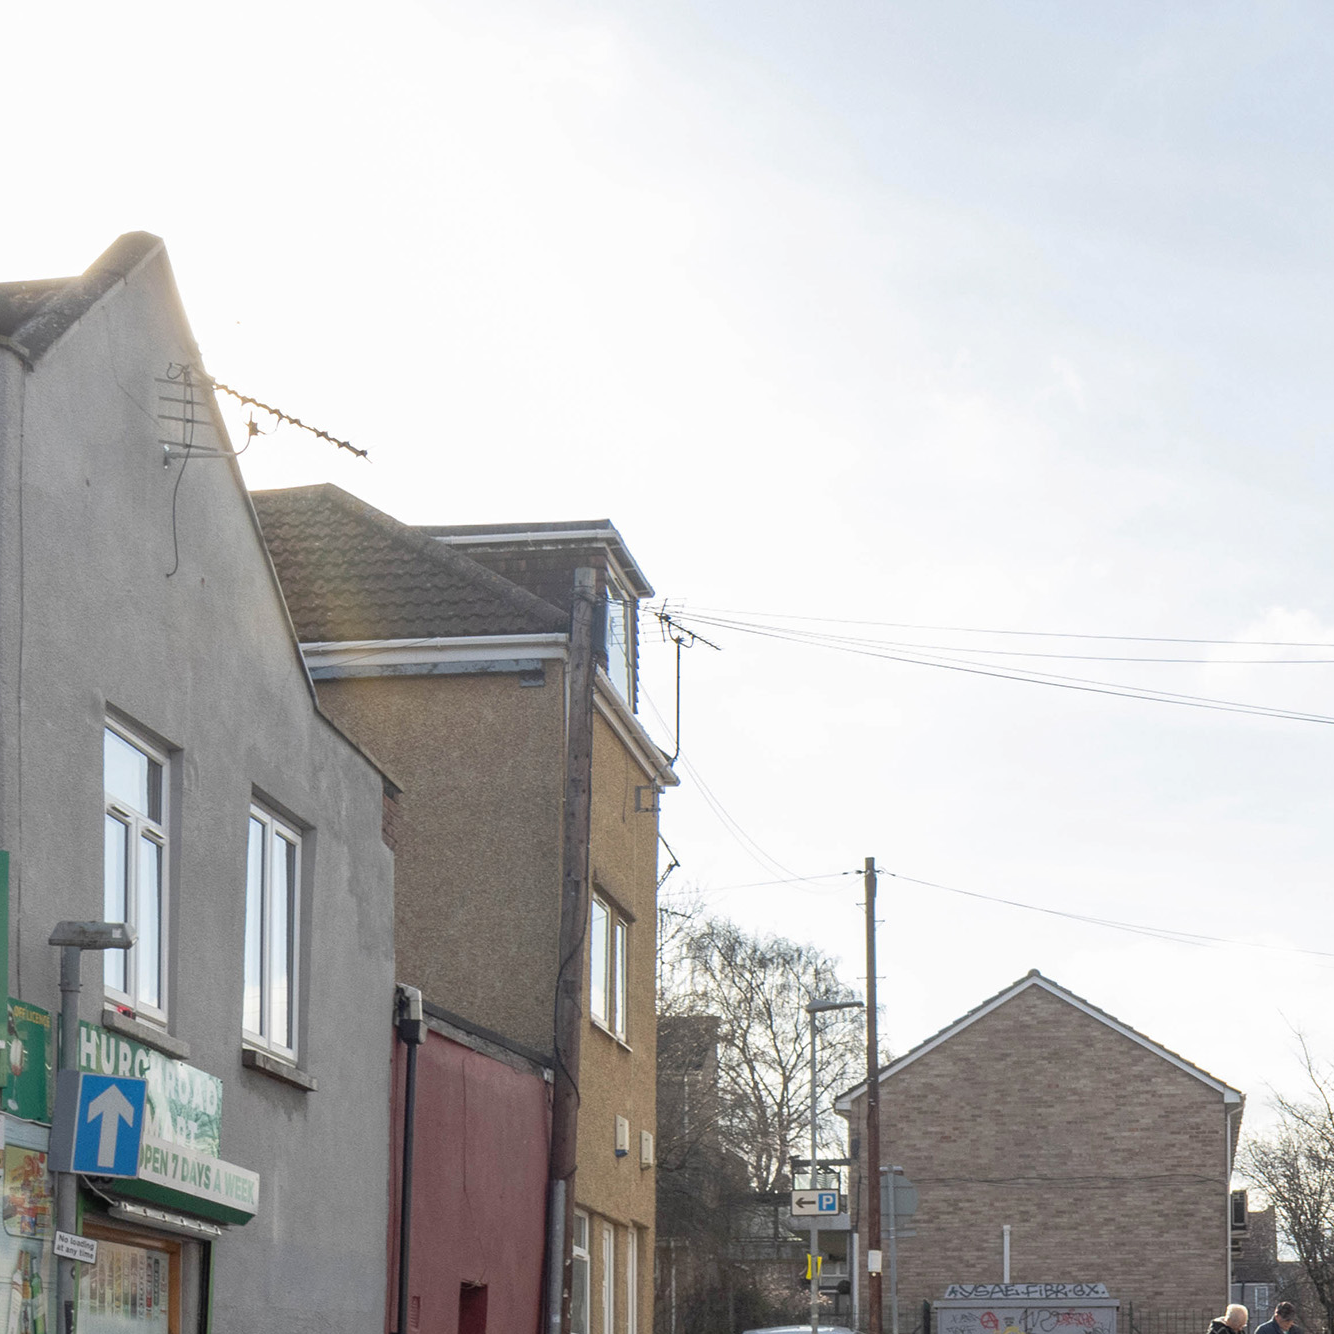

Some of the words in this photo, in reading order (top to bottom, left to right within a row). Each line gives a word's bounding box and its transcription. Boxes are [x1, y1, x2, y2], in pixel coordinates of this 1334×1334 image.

[171, 1152, 179, 1179] 7
[181, 1156, 211, 1190] DAYS
[213, 1168, 222, 1194] A
[224, 1171, 254, 1205] WEEK
[822, 1195, 833, 1210] P
[59, 1234, 68, 1243] No
[70, 1237, 94, 1251] loading
[56, 1244, 64, 1252] at
[65, 1246, 77, 1256] any
[79, 1249, 94, 1259] time
